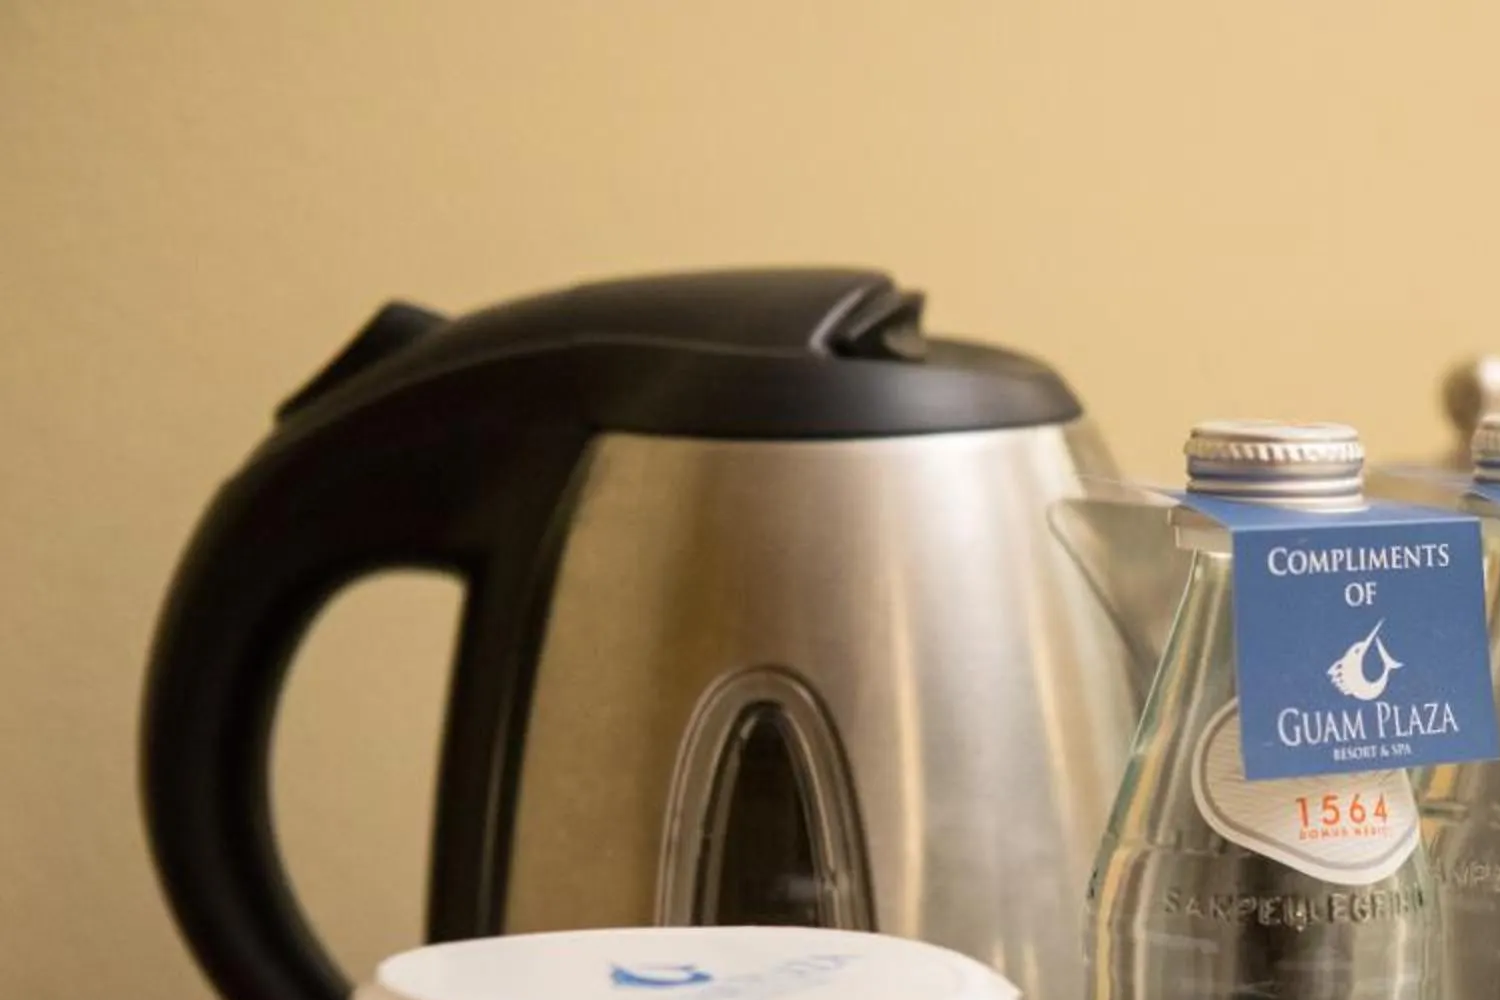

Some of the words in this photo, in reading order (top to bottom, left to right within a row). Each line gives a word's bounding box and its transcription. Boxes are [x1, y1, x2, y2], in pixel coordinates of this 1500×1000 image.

[1267, 543, 1450, 576] COMPLIMENTS
[1344, 582, 1377, 607] OF
[1277, 707, 1367, 747] GUAM
[1376, 701, 1460, 739] PLAZA
[1333, 744, 1377, 761] RESORT
[1380, 744, 1390, 758] &
[1392, 743, 1412, 757] SPA
[1295, 792, 1388, 828] 1564
